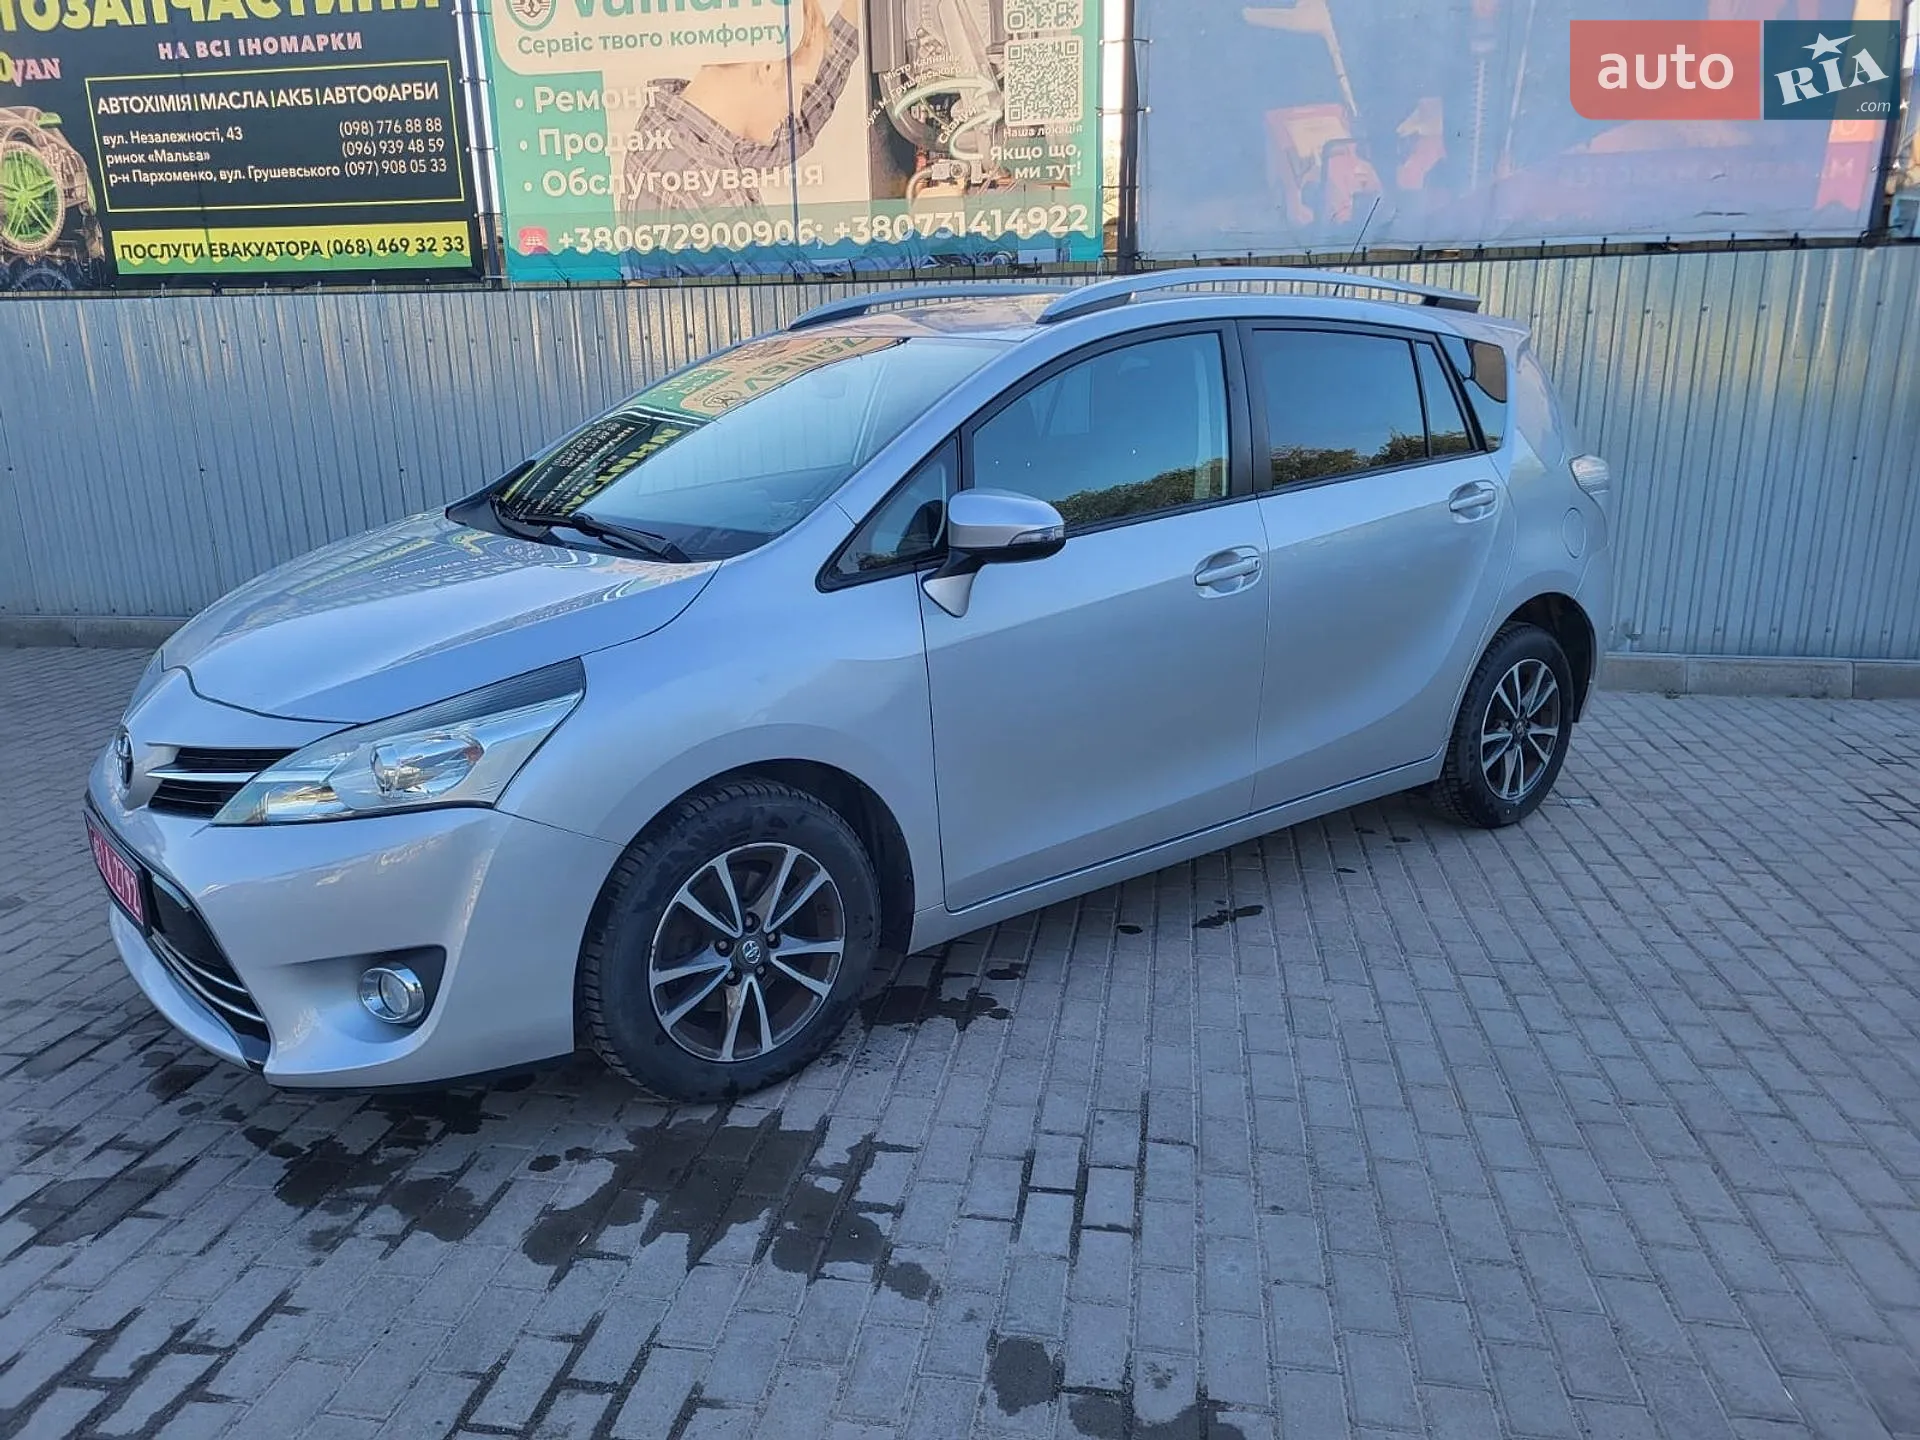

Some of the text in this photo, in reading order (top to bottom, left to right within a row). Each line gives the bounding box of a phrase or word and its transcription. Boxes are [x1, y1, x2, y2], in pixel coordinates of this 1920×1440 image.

[158, 31, 363, 60] НА ВСІ ІНОМАРКИ
[518, 23, 789, 58] Сервіс твого комфорту
[97, 82, 439, 115] АВТОХІМІЯ МАСЛА АКБ АВТОФАРБИ
[534, 86, 660, 113] Ремонт
[102, 126, 243, 149] вул. Незалежності, 43
[339, 117, 443, 138] (098) 776 88 88
[342, 138, 445, 158] (096) 939 48 59
[538, 126, 674, 161] Продаж
[990, 143, 1082, 161] Якщо що,
[106, 149, 211, 168] ринок «Мальва»
[345, 157, 447, 178] (097) 908 05 33
[1014, 160, 1081, 181] ми тут!
[109, 163, 340, 187] р-н Пархоменко, вул. Грушевського
[542, 163, 824, 200] Обслуговування
[834, 203, 1088, 245] +380731414922
[120, 235, 466, 261] ПОСЛУГИ ЕВАКУАТОРА (068) 469 32 33
